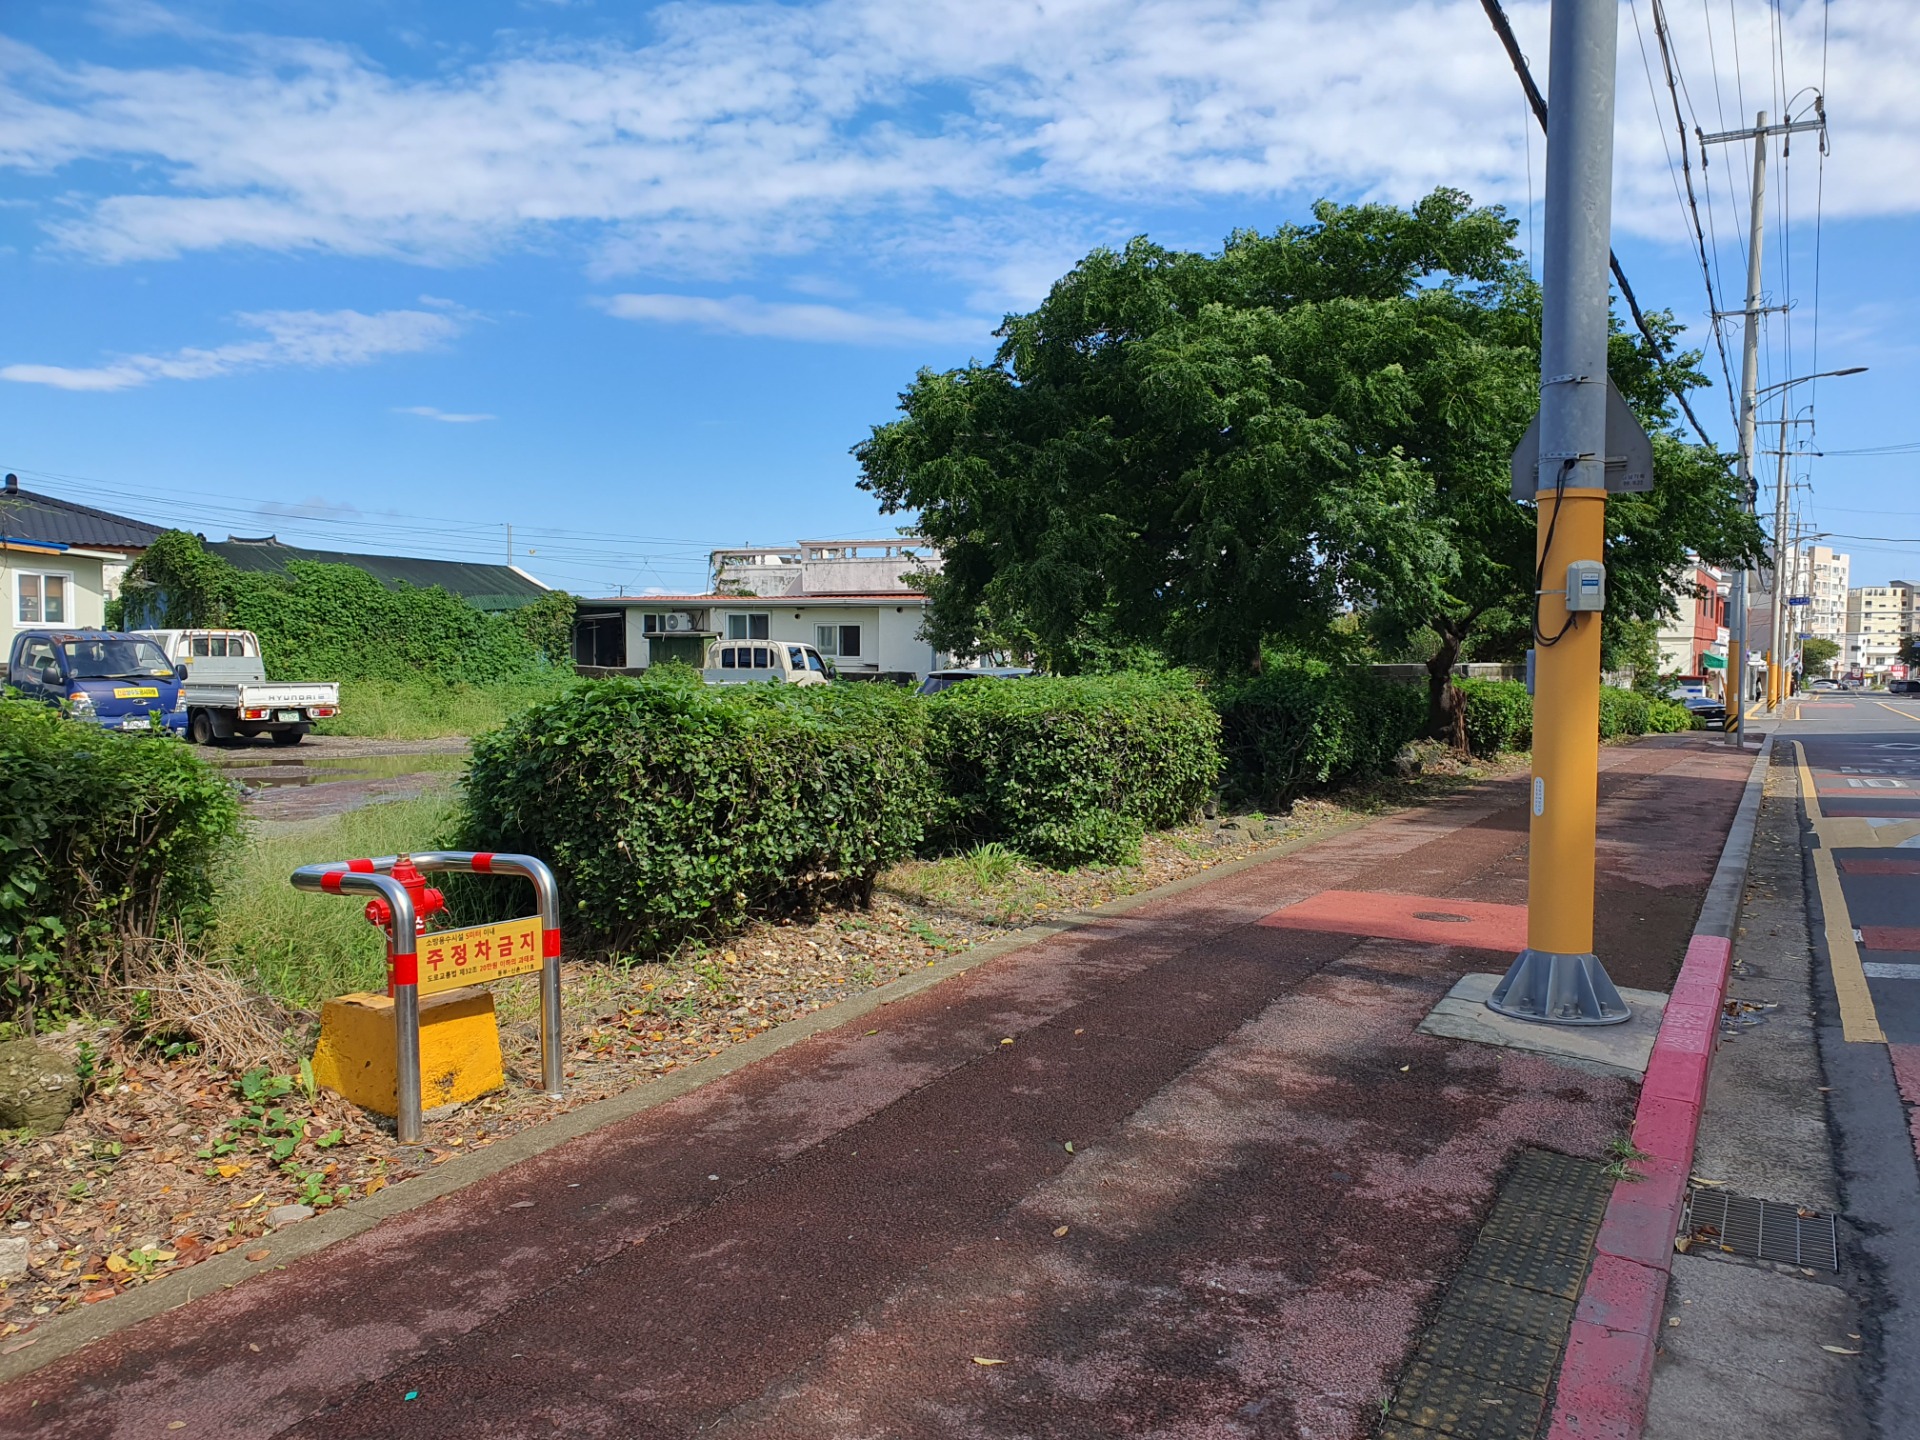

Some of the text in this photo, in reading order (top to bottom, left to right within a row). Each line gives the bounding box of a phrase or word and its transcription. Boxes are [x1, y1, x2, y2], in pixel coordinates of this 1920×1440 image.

[426, 927, 496, 947] 소방용수시설 5미터 이내
[427, 970, 457, 983] 도로교통법
[480, 962, 498, 972] 20만원
[500, 957, 517, 967] 이하의
[518, 954, 535, 964] 과태료
